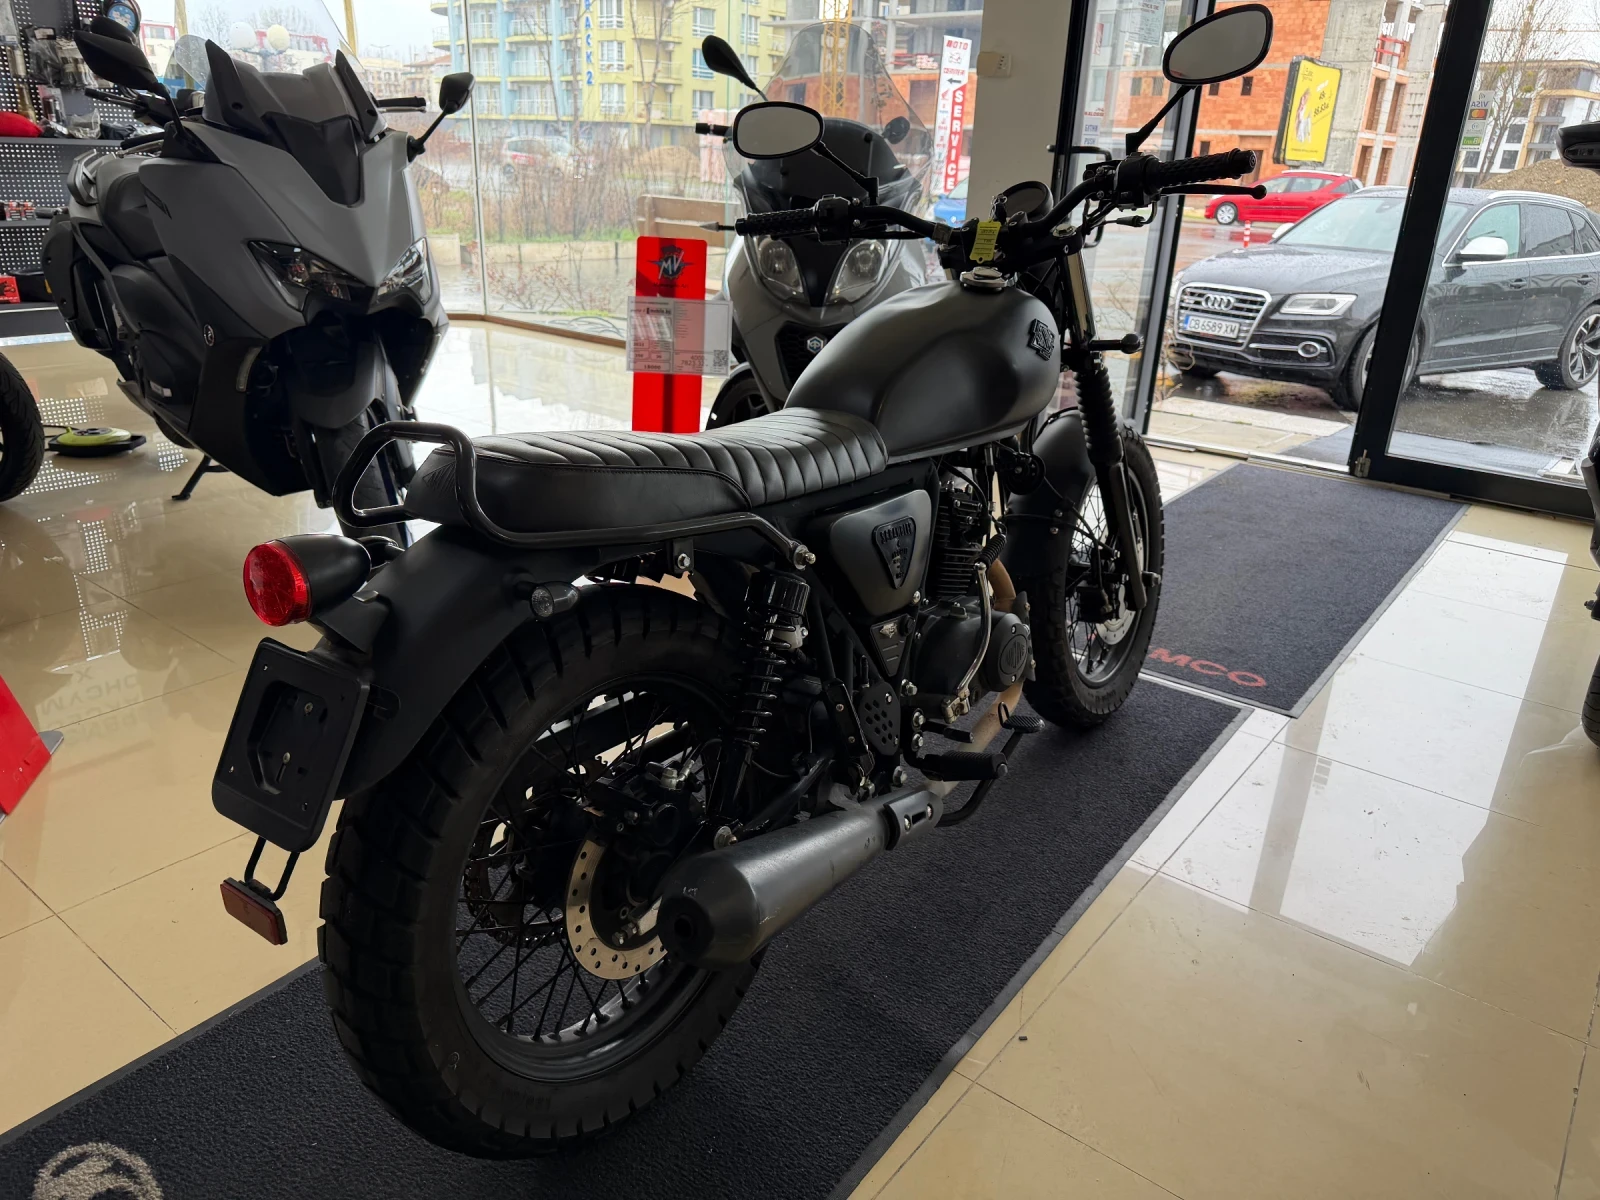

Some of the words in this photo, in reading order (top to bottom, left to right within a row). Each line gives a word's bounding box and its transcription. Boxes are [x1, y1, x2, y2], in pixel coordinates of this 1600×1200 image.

[946, 39, 969, 51] MOTO
[586, 71, 593, 85] 2
[946, 89, 964, 190] SERVICE
[1201, 321, 1223, 334] 6589
[1148, 646, 1266, 687] MCO
